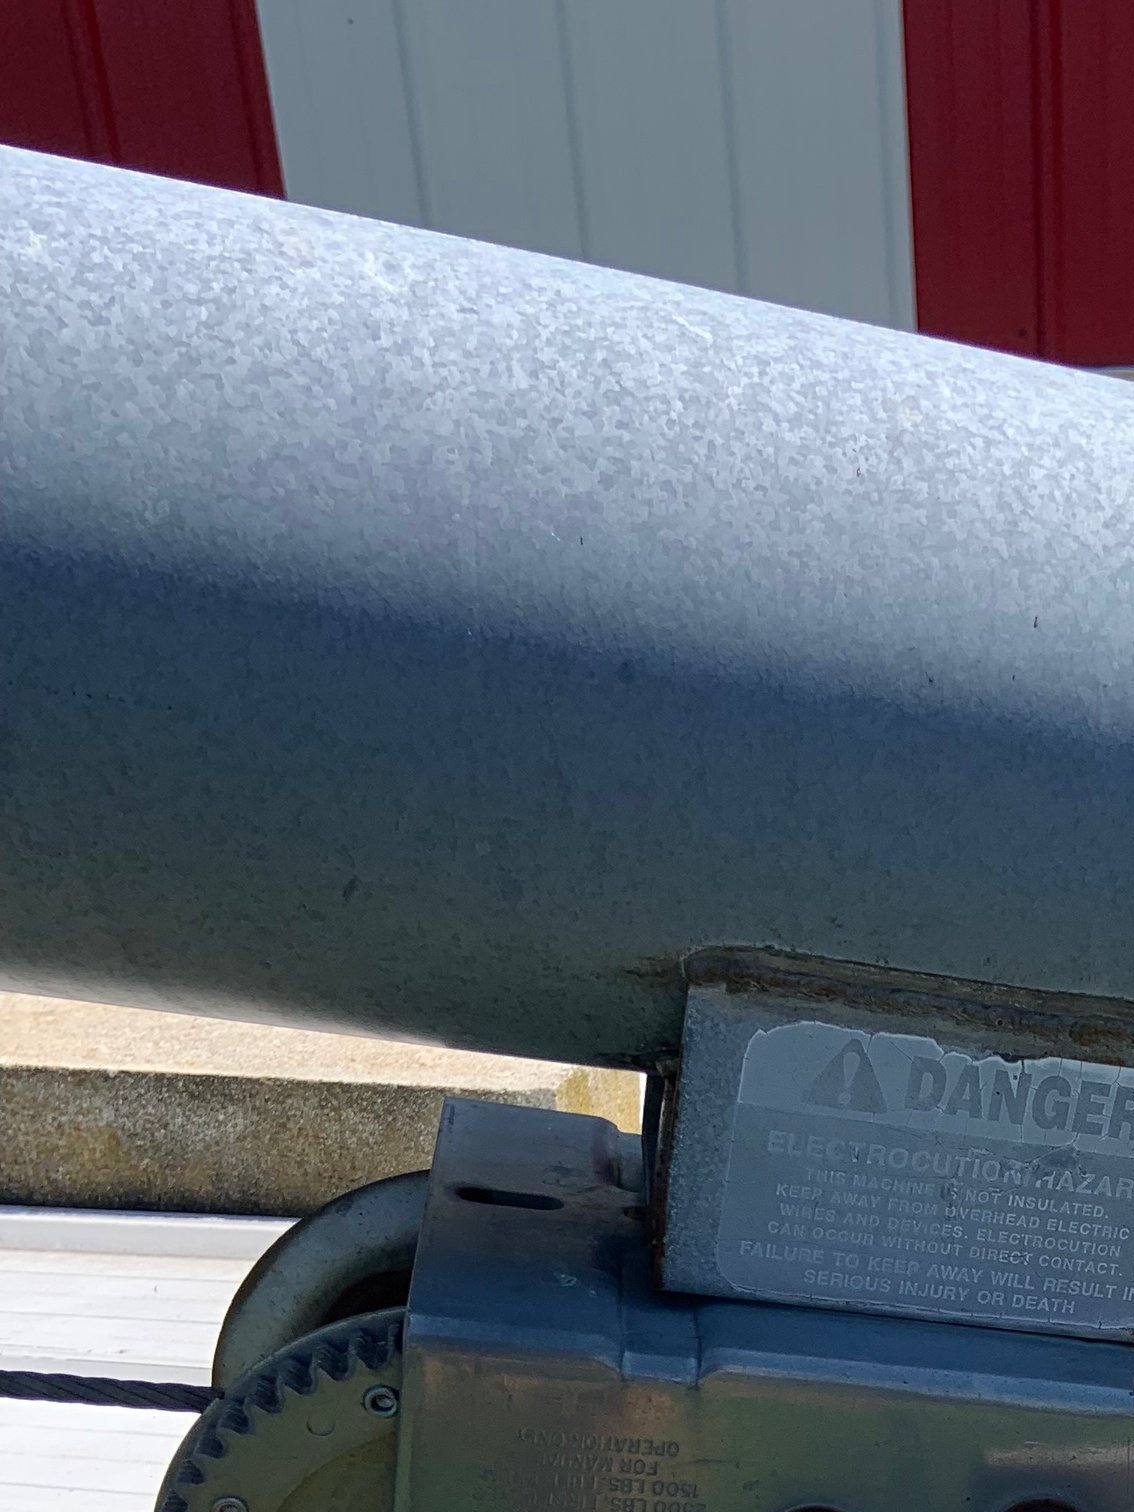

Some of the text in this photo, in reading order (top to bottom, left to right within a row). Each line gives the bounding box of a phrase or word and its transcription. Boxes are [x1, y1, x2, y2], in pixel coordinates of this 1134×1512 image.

[767, 1130, 1030, 1186] ELECTROCUTION
[775, 1183, 1132, 1240] KEEP AWAY FROM OVERHEAD ELECTRIC
[805, 1167, 846, 1185] THIS
[852, 1174, 935, 1197] MACHINE
[965, 1188, 1002, 1206] NOT
[1008, 1193, 1110, 1219] INSULATED.
[767, 1220, 1124, 1278] CAN OCCUR WITHOUT DIRECT CONTACT.
[779, 1202, 1122, 1258] WIRES AND DEVICES. ELECTROCUTION
[738, 1239, 825, 1265] FAILURE
[832, 1251, 860, 1269] TO
[867, 1255, 921, 1276] KEEP
[926, 1263, 985, 1285] AWAY
[990, 1269, 1036, 1292] WILL
[1043, 1278, 1118, 1300] RESULT
[803, 1268, 1077, 1315] SERIOUS INJURY OR DEATH
[619, 1458, 659, 1477] FOR
[652, 1480, 700, 1499] 1500
